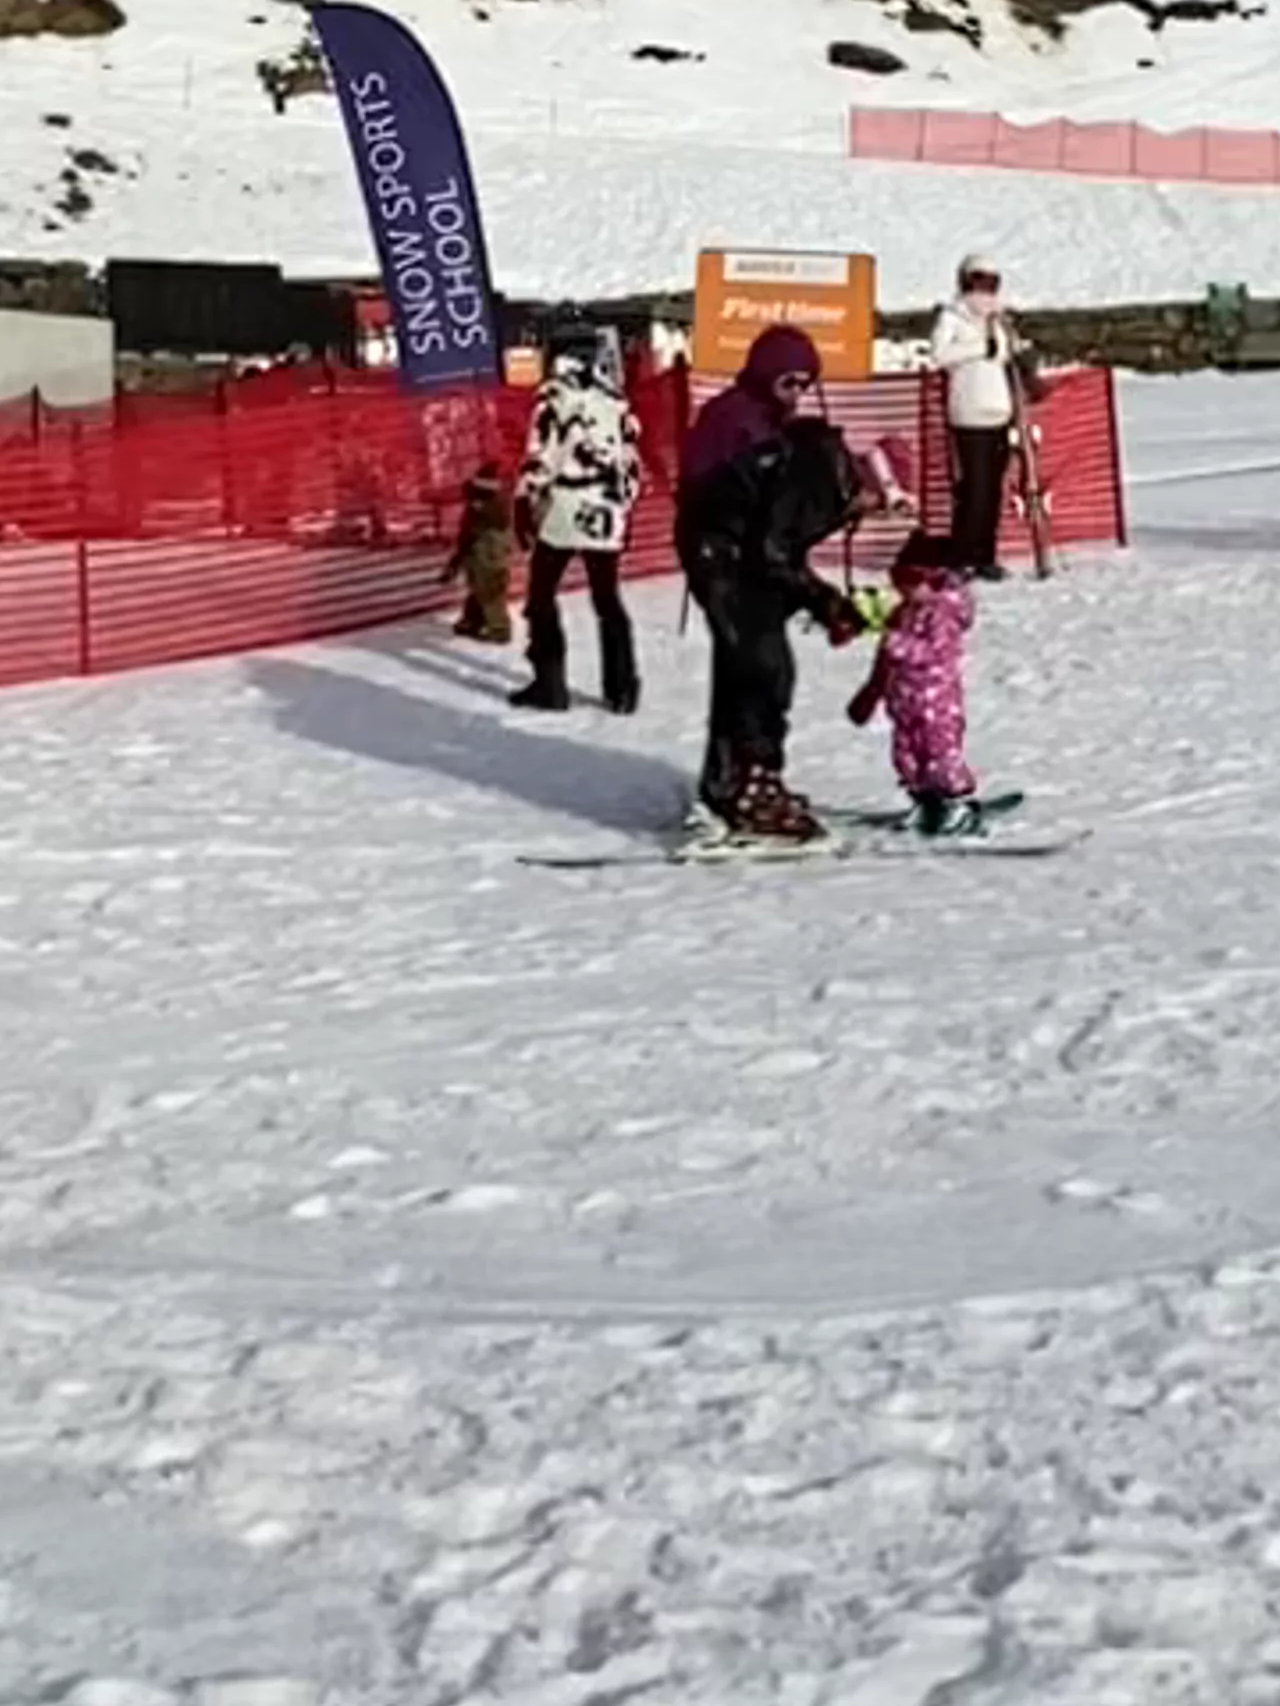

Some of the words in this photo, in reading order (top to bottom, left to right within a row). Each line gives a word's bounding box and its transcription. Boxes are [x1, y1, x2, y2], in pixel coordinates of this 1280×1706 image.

[351, 72, 416, 219] SPORTS
[387, 231, 445, 354] SNOW
[425, 177, 486, 347] SCHOOL
[721, 296, 783, 321] First
